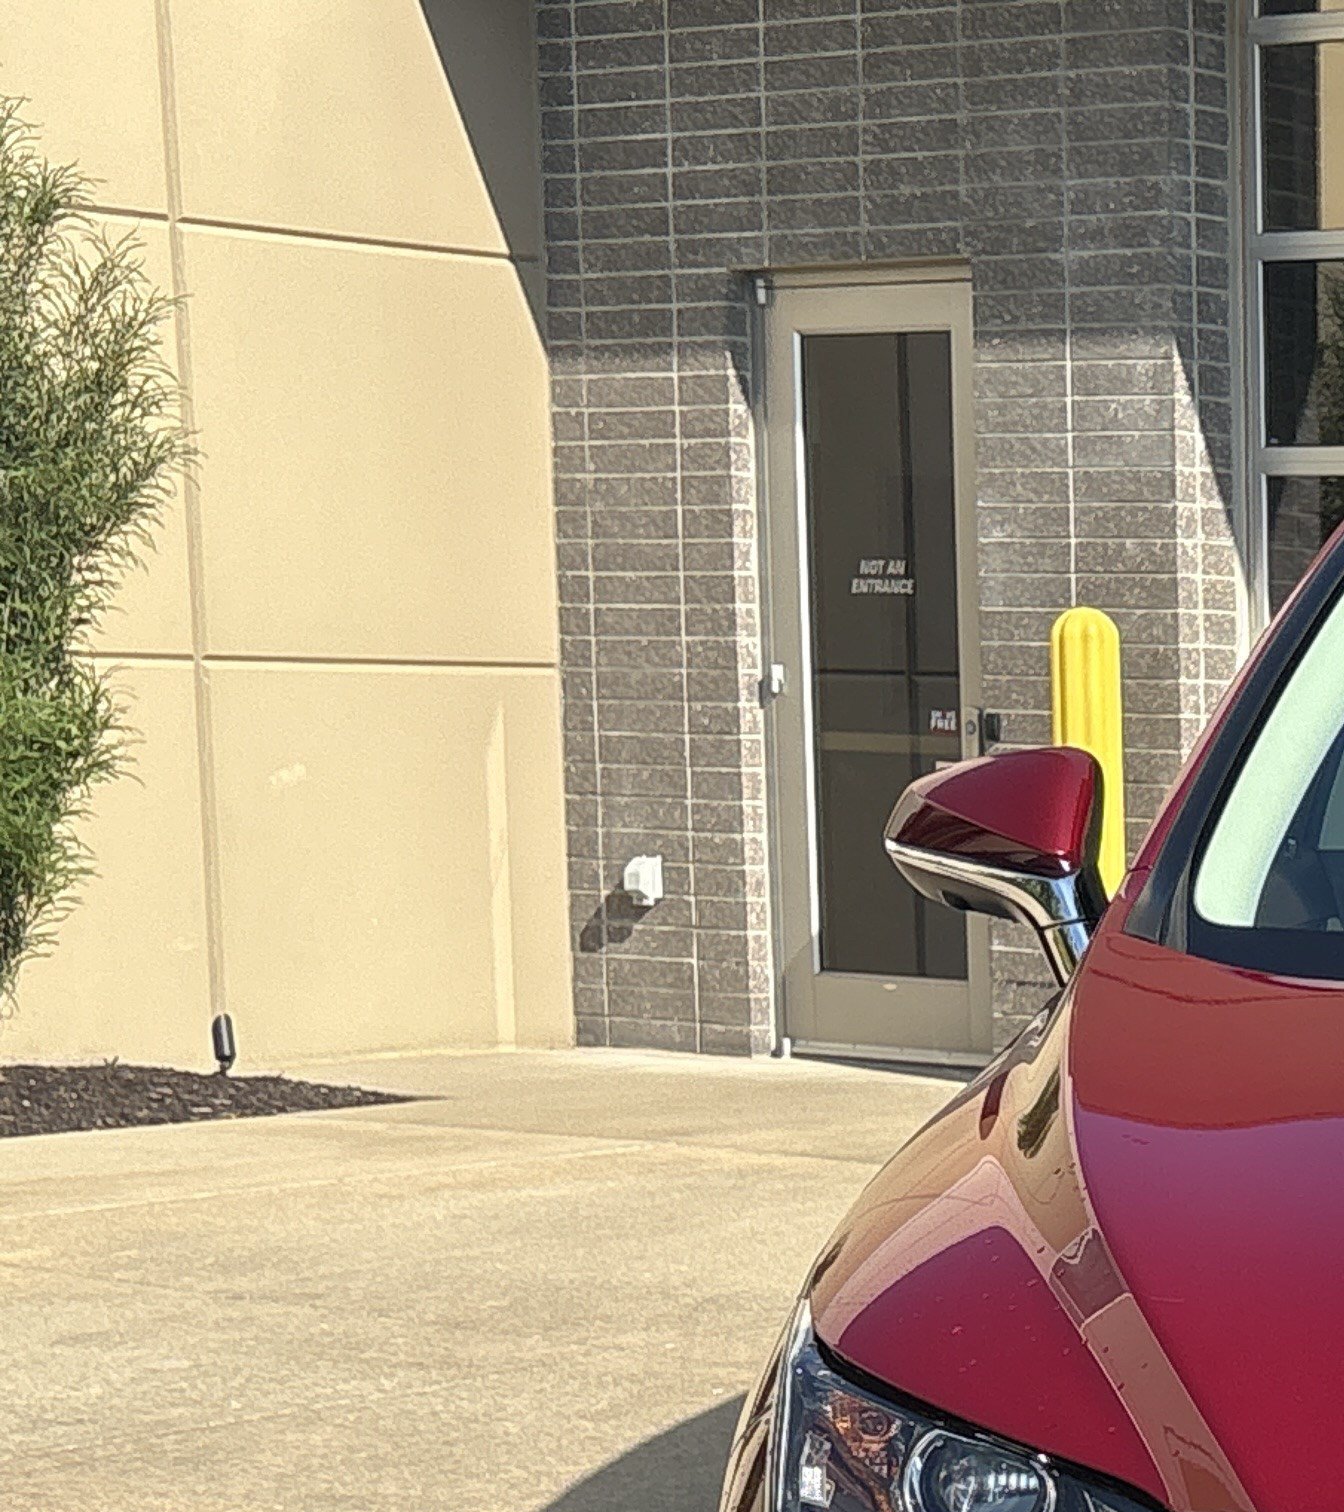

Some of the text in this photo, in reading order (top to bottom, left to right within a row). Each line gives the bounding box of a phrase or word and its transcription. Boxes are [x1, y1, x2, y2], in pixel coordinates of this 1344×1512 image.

[859, 559, 907, 575] NOT AN
[851, 578, 915, 595] ENTRANCE
